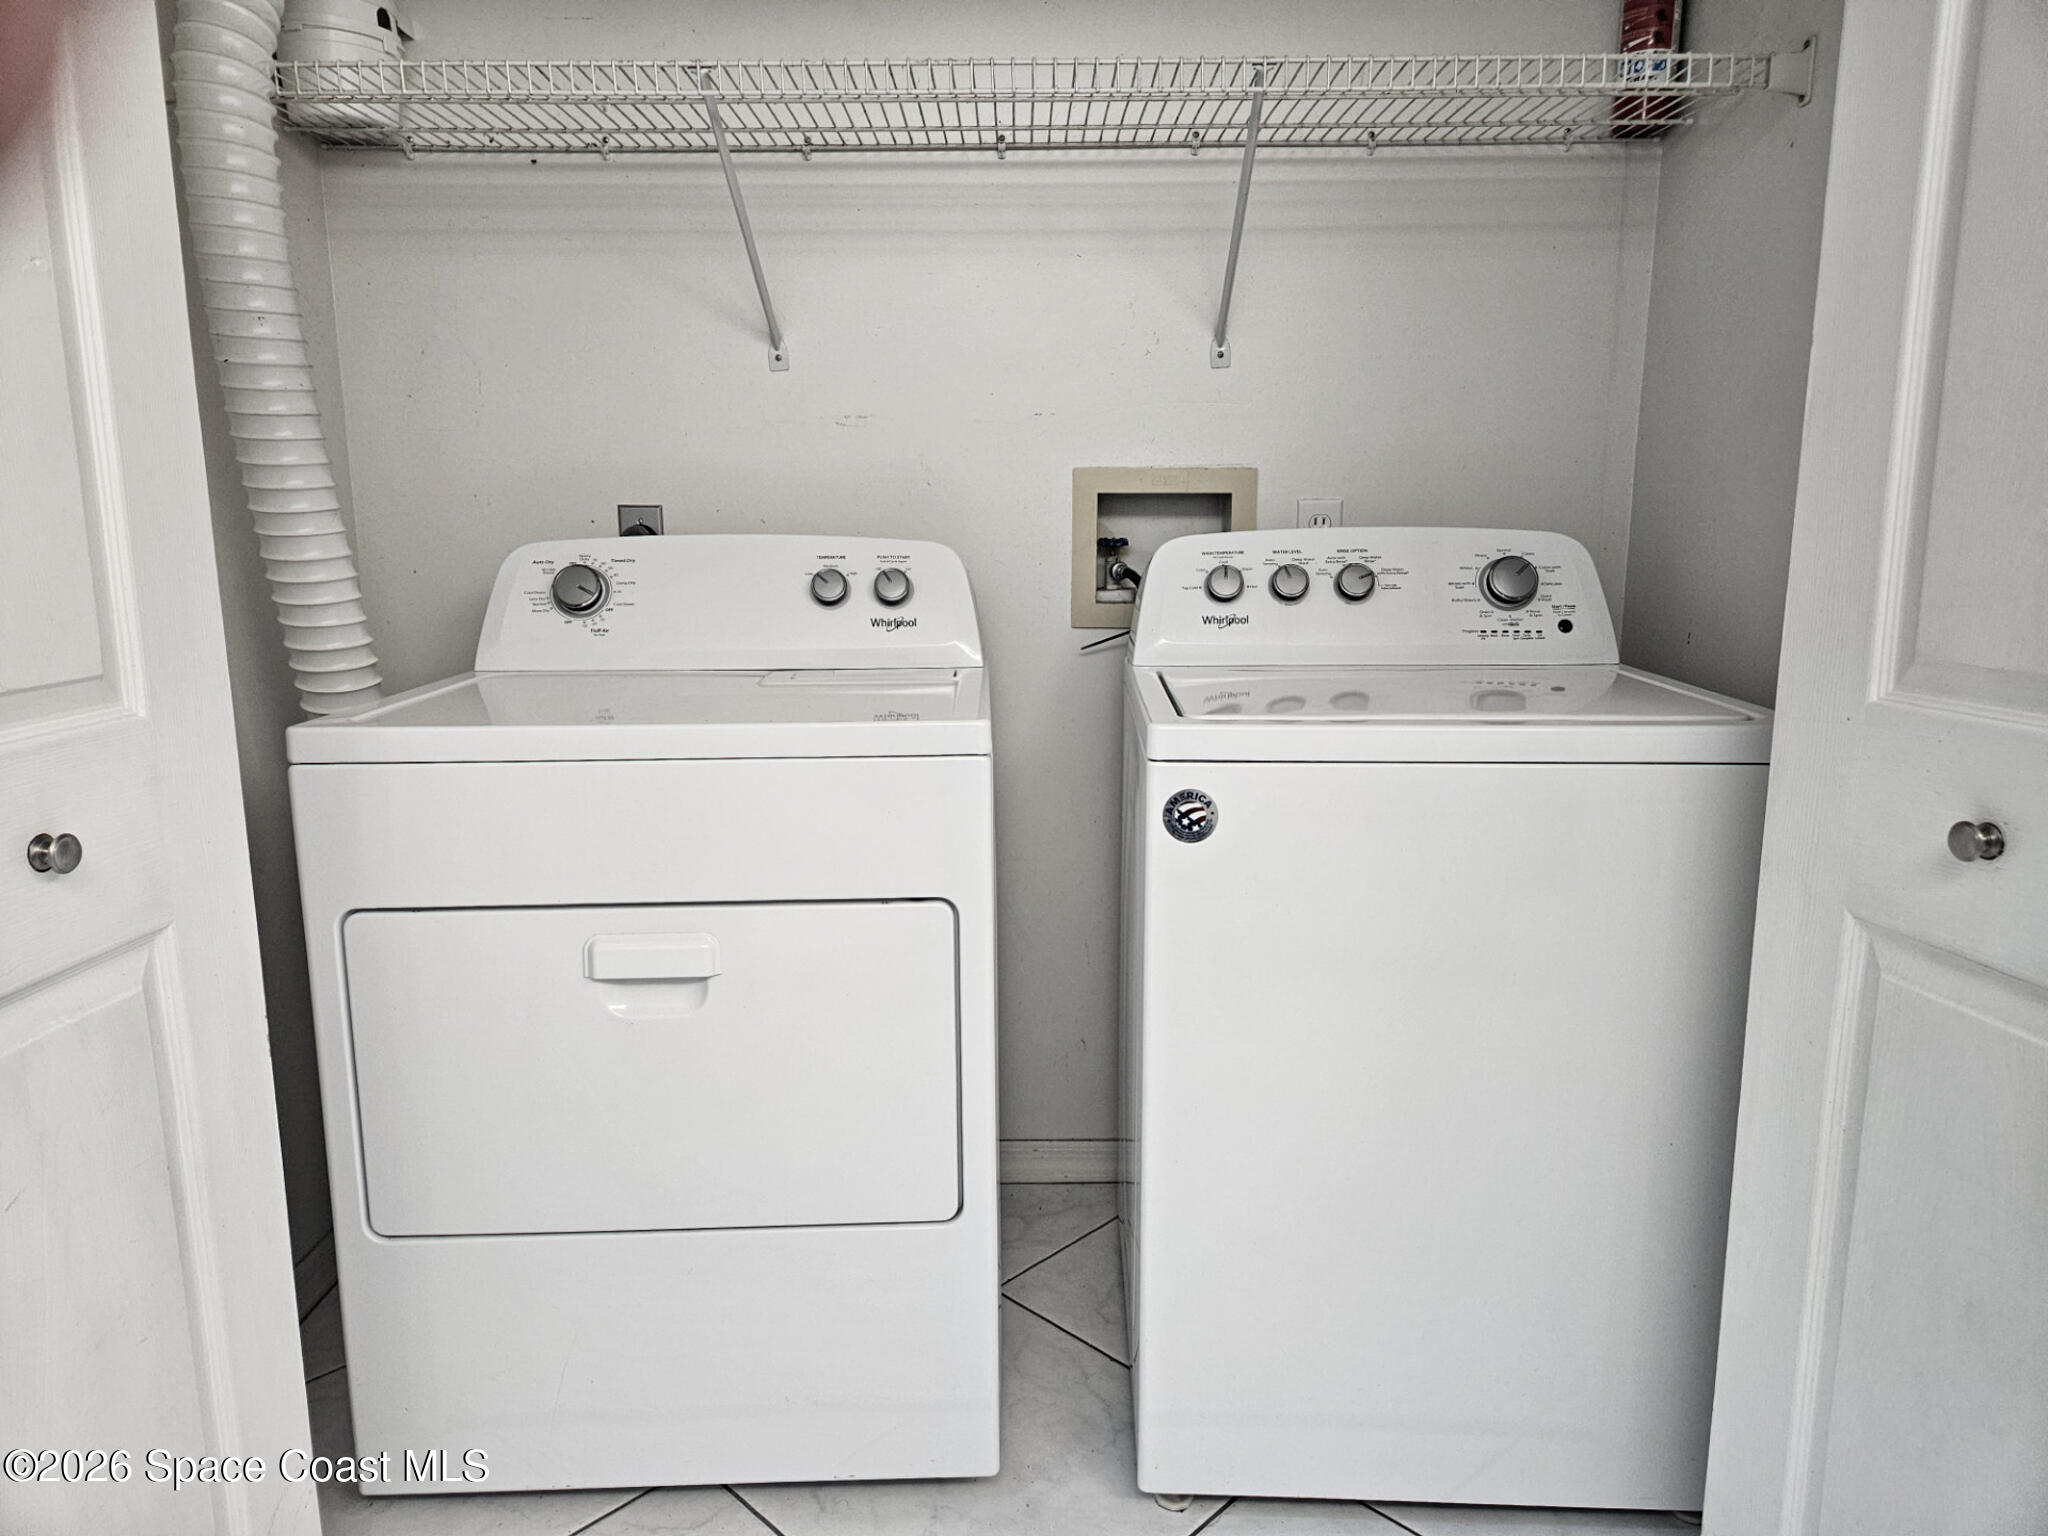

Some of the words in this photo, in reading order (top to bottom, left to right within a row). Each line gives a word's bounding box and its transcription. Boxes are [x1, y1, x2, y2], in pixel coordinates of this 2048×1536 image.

[870, 616, 917, 632] Whirlpool
[1201, 613, 1249, 629] Whirlpool
[1165, 791, 1213, 816] AMERICA
